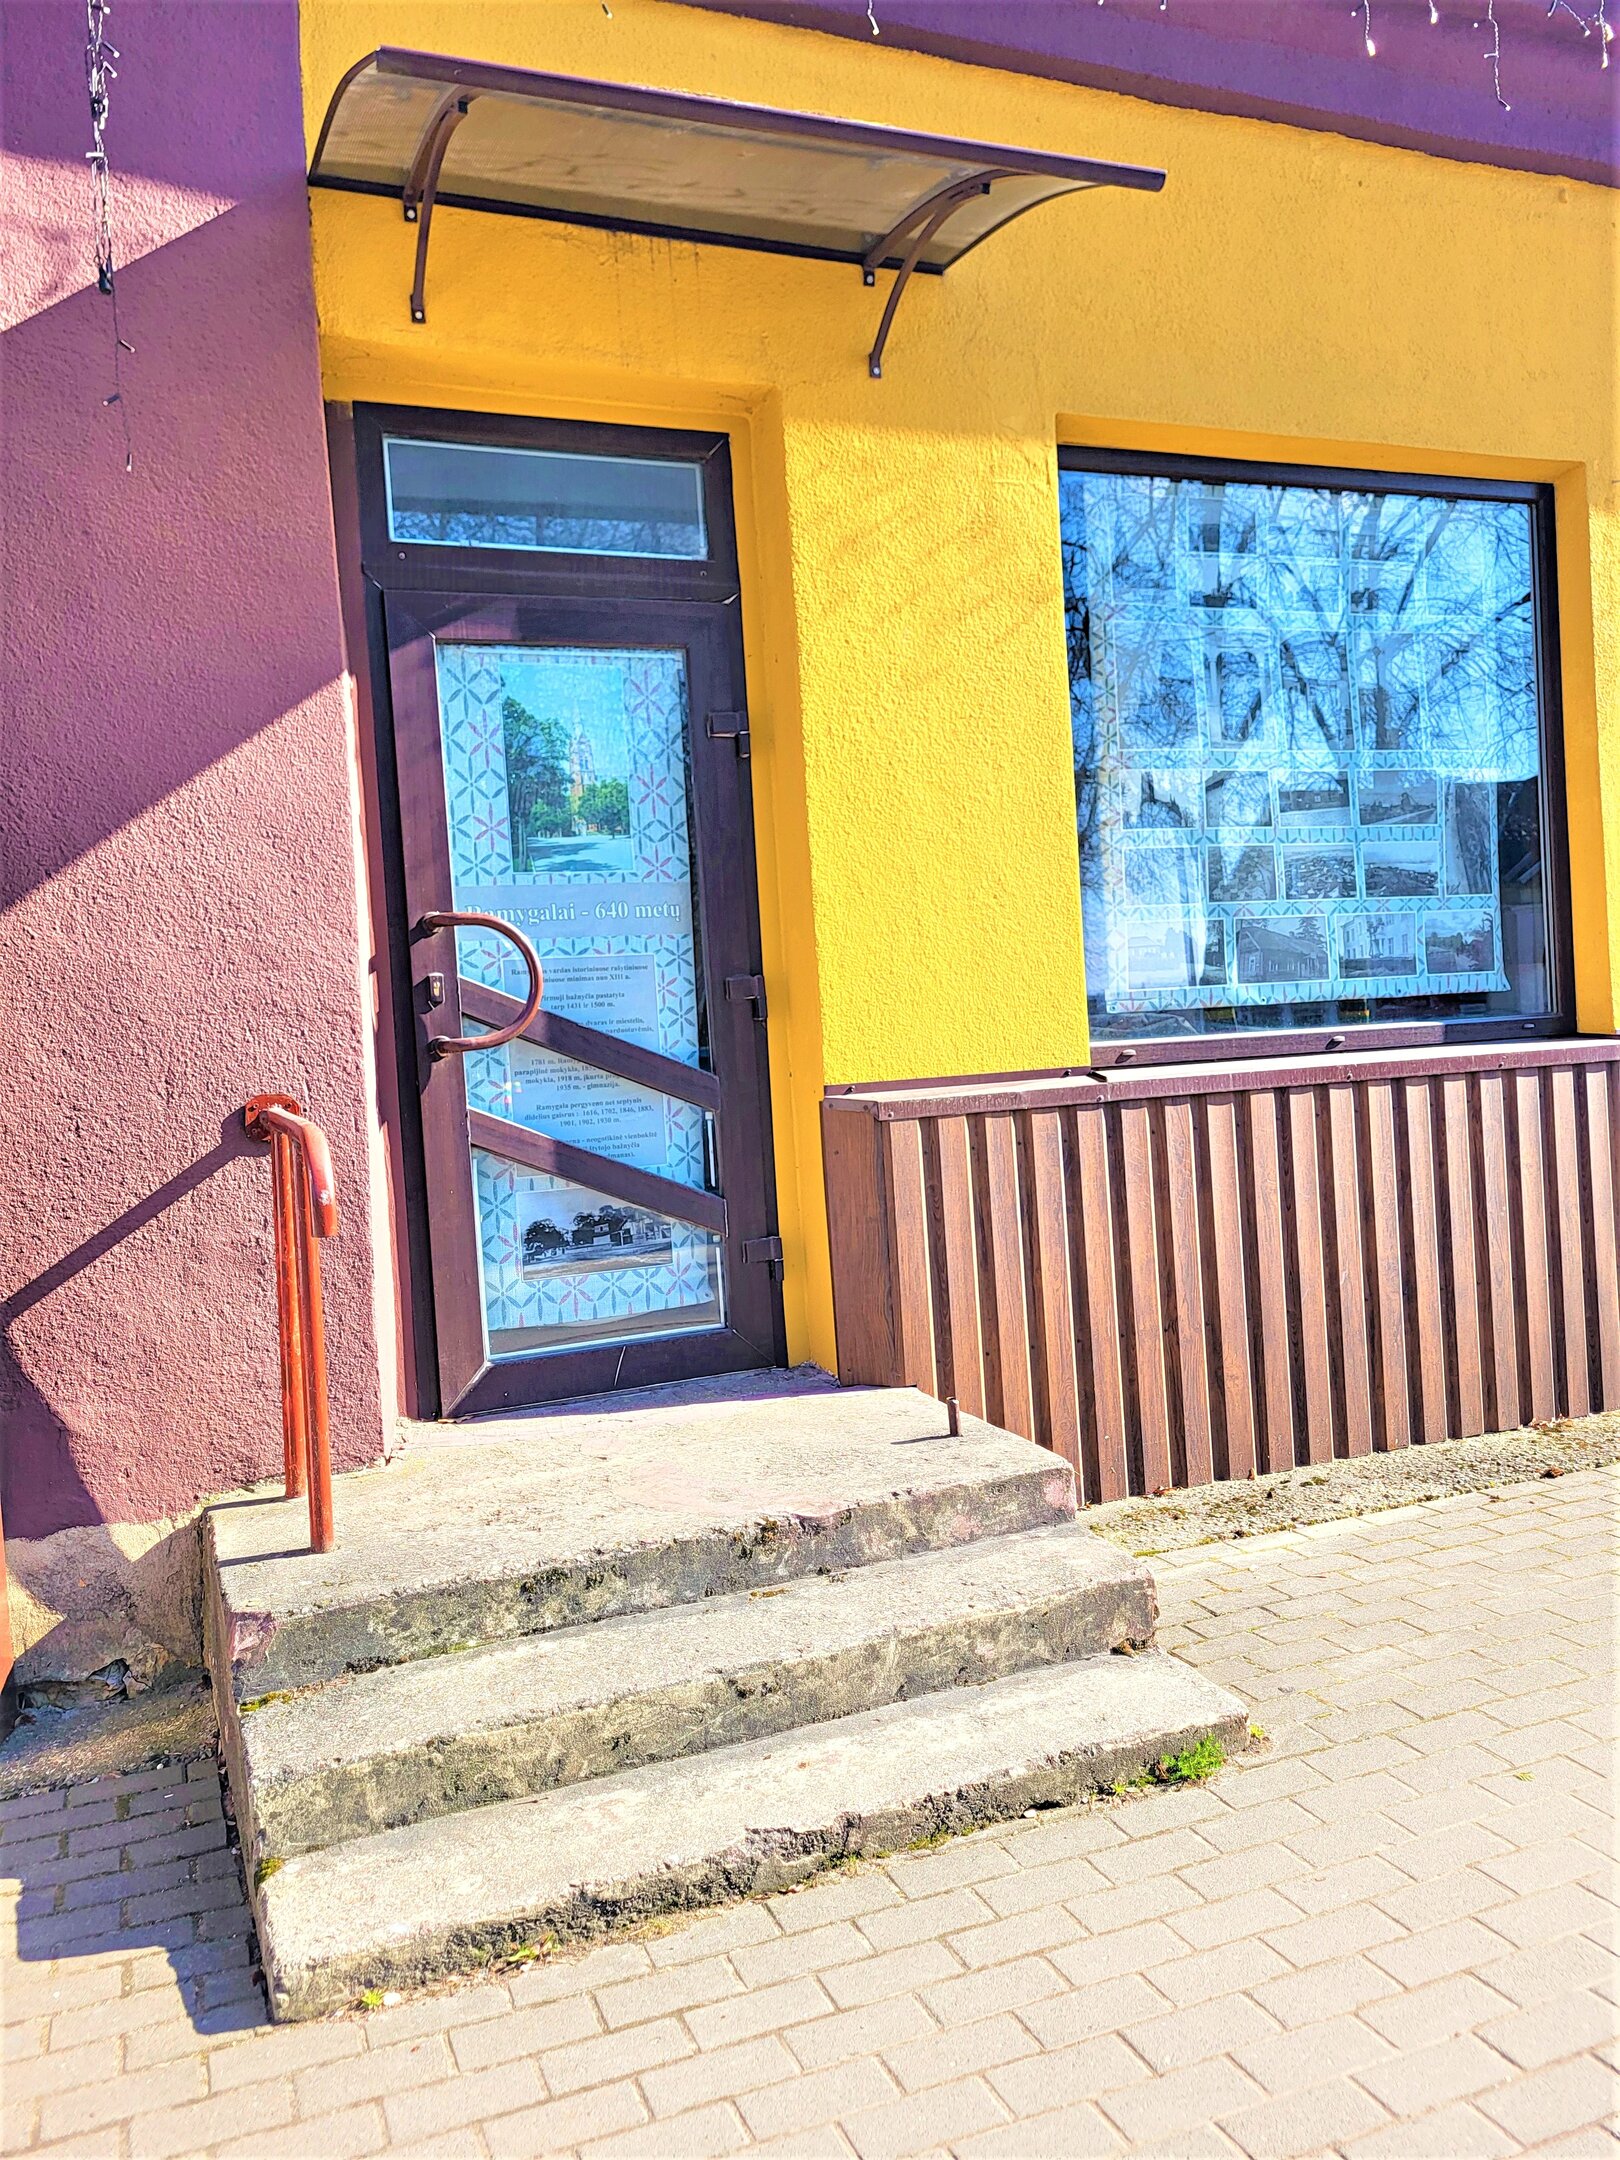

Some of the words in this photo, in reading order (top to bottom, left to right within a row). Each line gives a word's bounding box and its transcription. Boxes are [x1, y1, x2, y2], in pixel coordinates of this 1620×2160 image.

[594, 901, 628, 920] 640
[635, 901, 681, 922] metų
[566, 992, 594, 1002] bažnyčia
[596, 992, 625, 1000] pastatyta
[525, 1076, 556, 1084] mokykla,
[536, 1103, 569, 1112] Ramygala
[570, 1101, 603, 1109] pergyveno
[616, 1097, 642, 1105] septynis
[524, 1113, 550, 1121] didelius
[552, 1112, 575, 1121] gaisrus
[612, 1141, 640, 1151] bažnyčia
